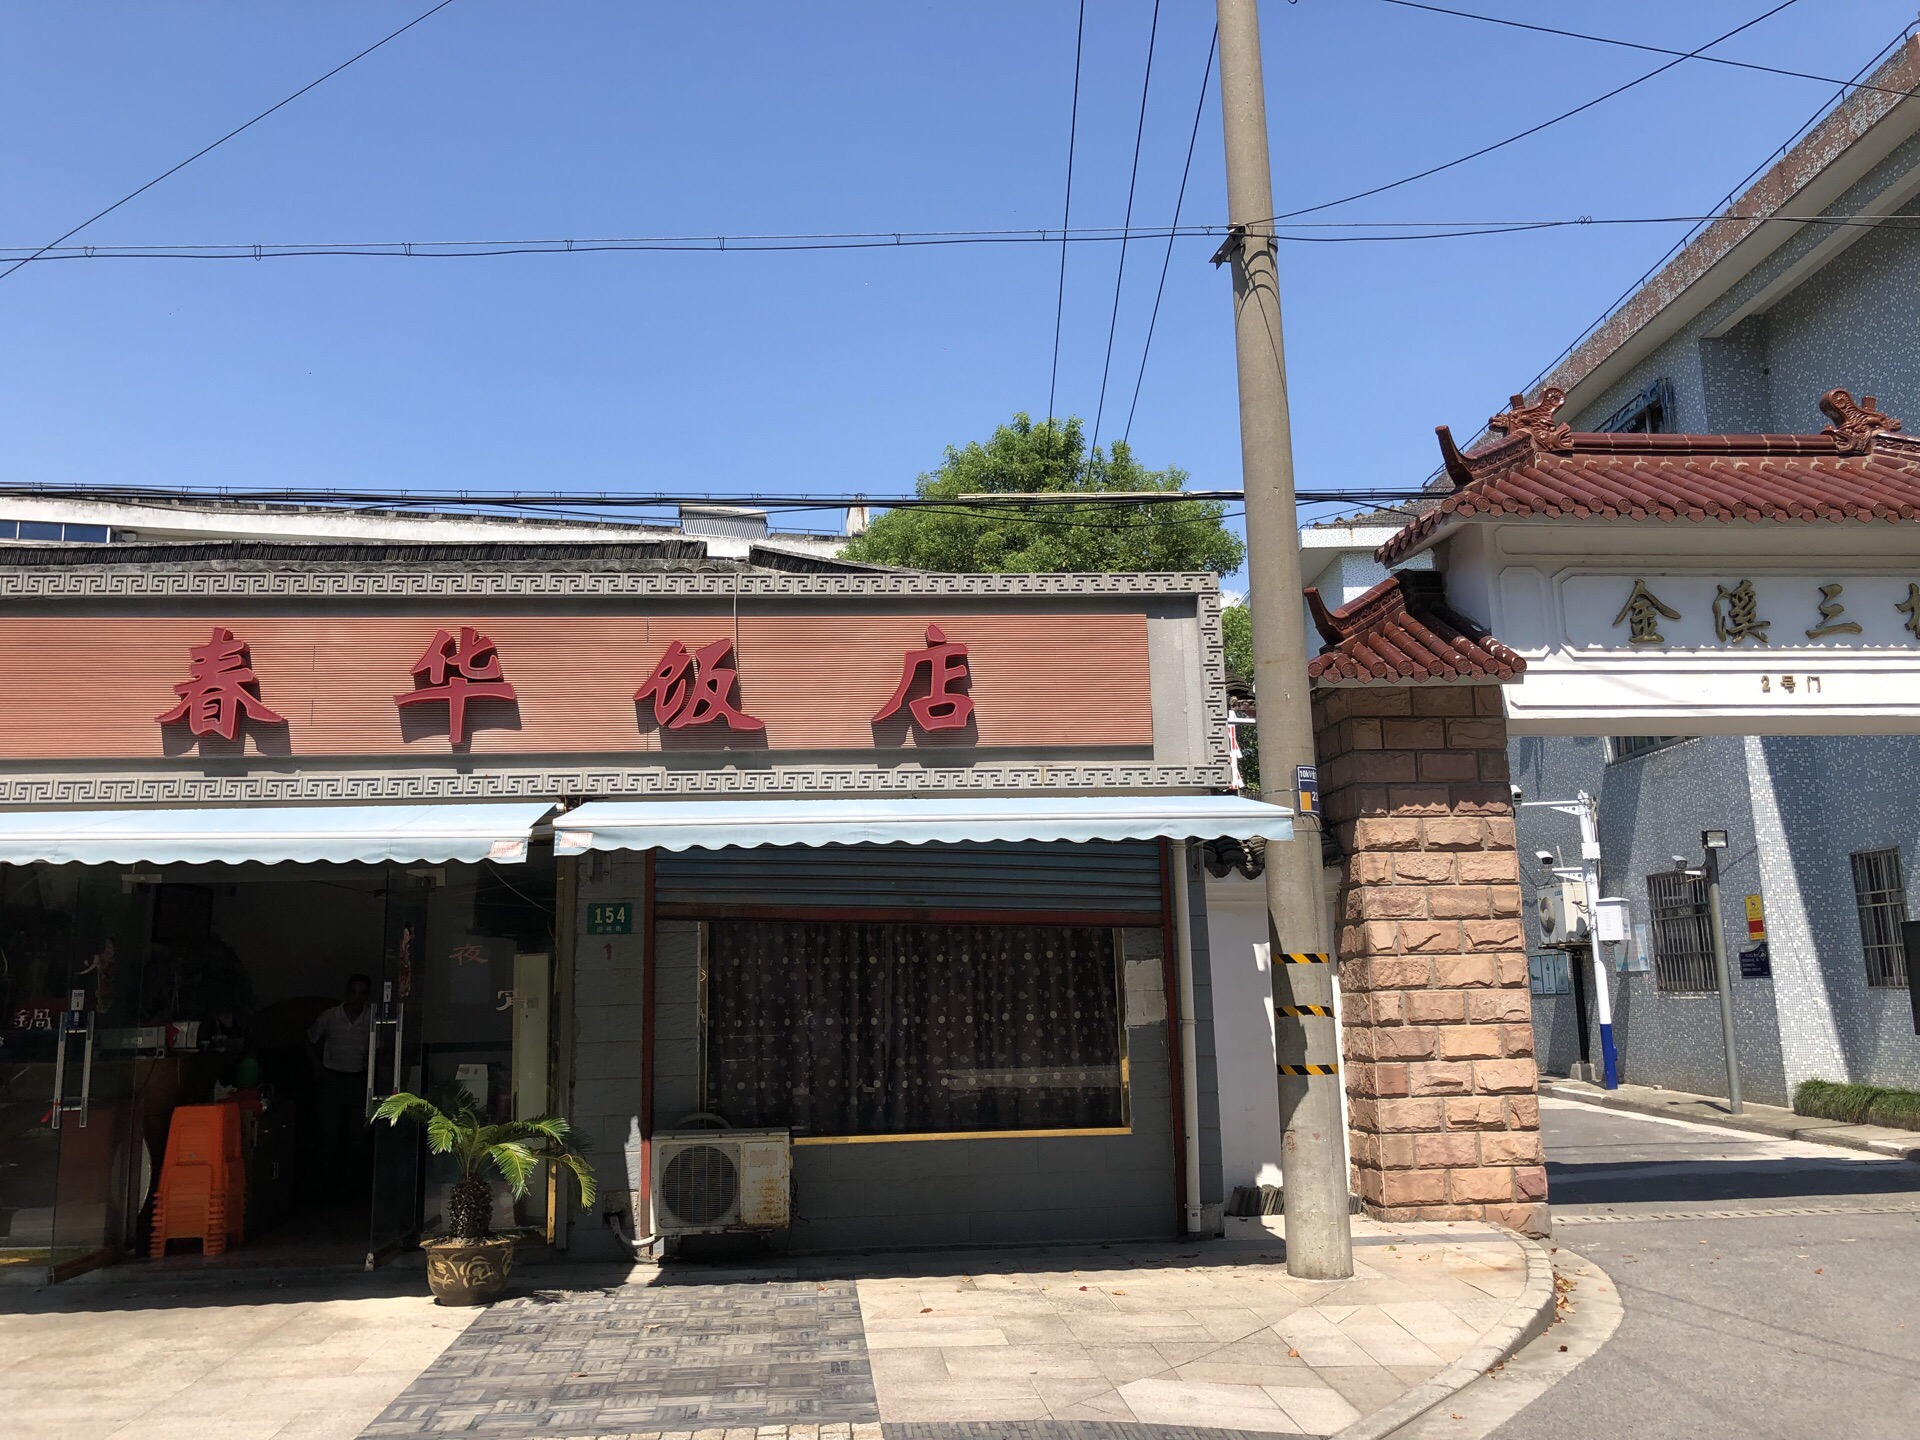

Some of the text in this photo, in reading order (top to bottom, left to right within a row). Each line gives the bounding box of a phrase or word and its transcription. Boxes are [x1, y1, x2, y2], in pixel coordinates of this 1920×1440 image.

[154, 623, 975, 744] 春华饭店
[1761, 675, 1822, 694] 2号门
[594, 906, 625, 924] 154
